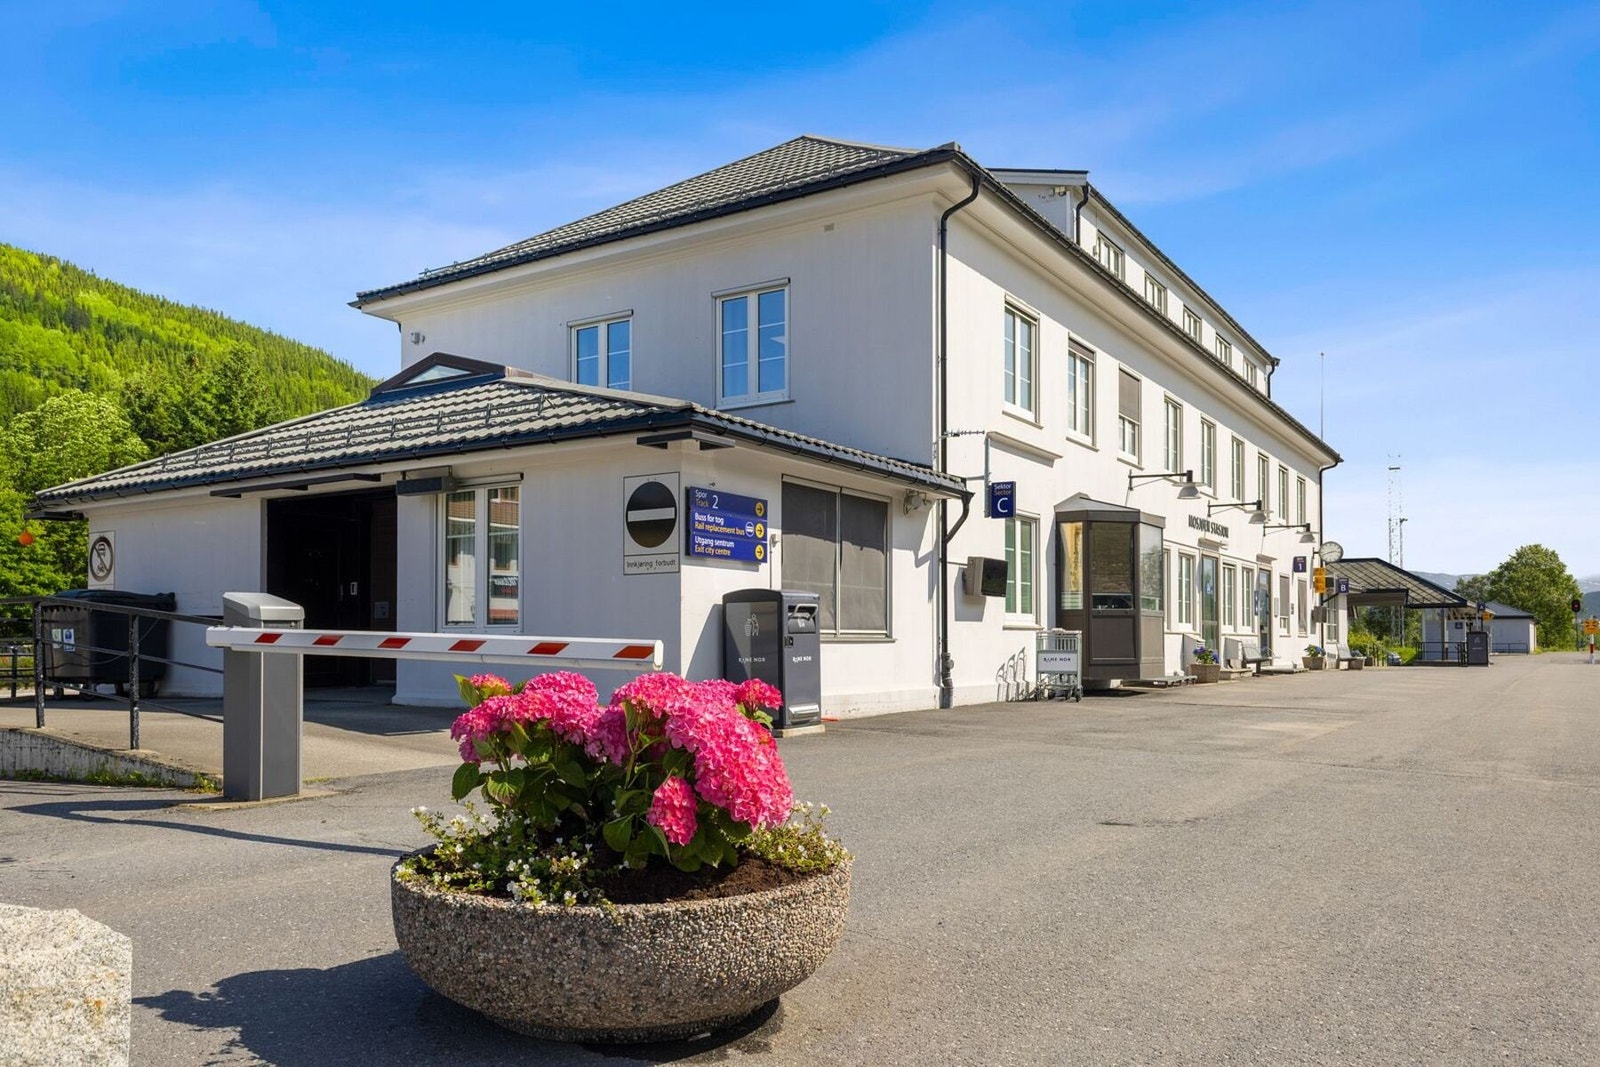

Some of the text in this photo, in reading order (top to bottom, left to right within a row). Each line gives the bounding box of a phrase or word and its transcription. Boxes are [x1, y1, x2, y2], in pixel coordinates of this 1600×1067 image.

[695, 489, 708, 500] Spor
[712, 495, 719, 509] 2
[997, 497, 1008, 513] C
[695, 512, 706, 522] Buss
[715, 516, 724, 526] tog
[705, 524, 736, 534] replacement
[736, 527, 745, 535] bus
[695, 536, 734, 548] Utgang sentrum
[705, 546, 714, 555] city
[626, 560, 653, 568] Innkjøring
